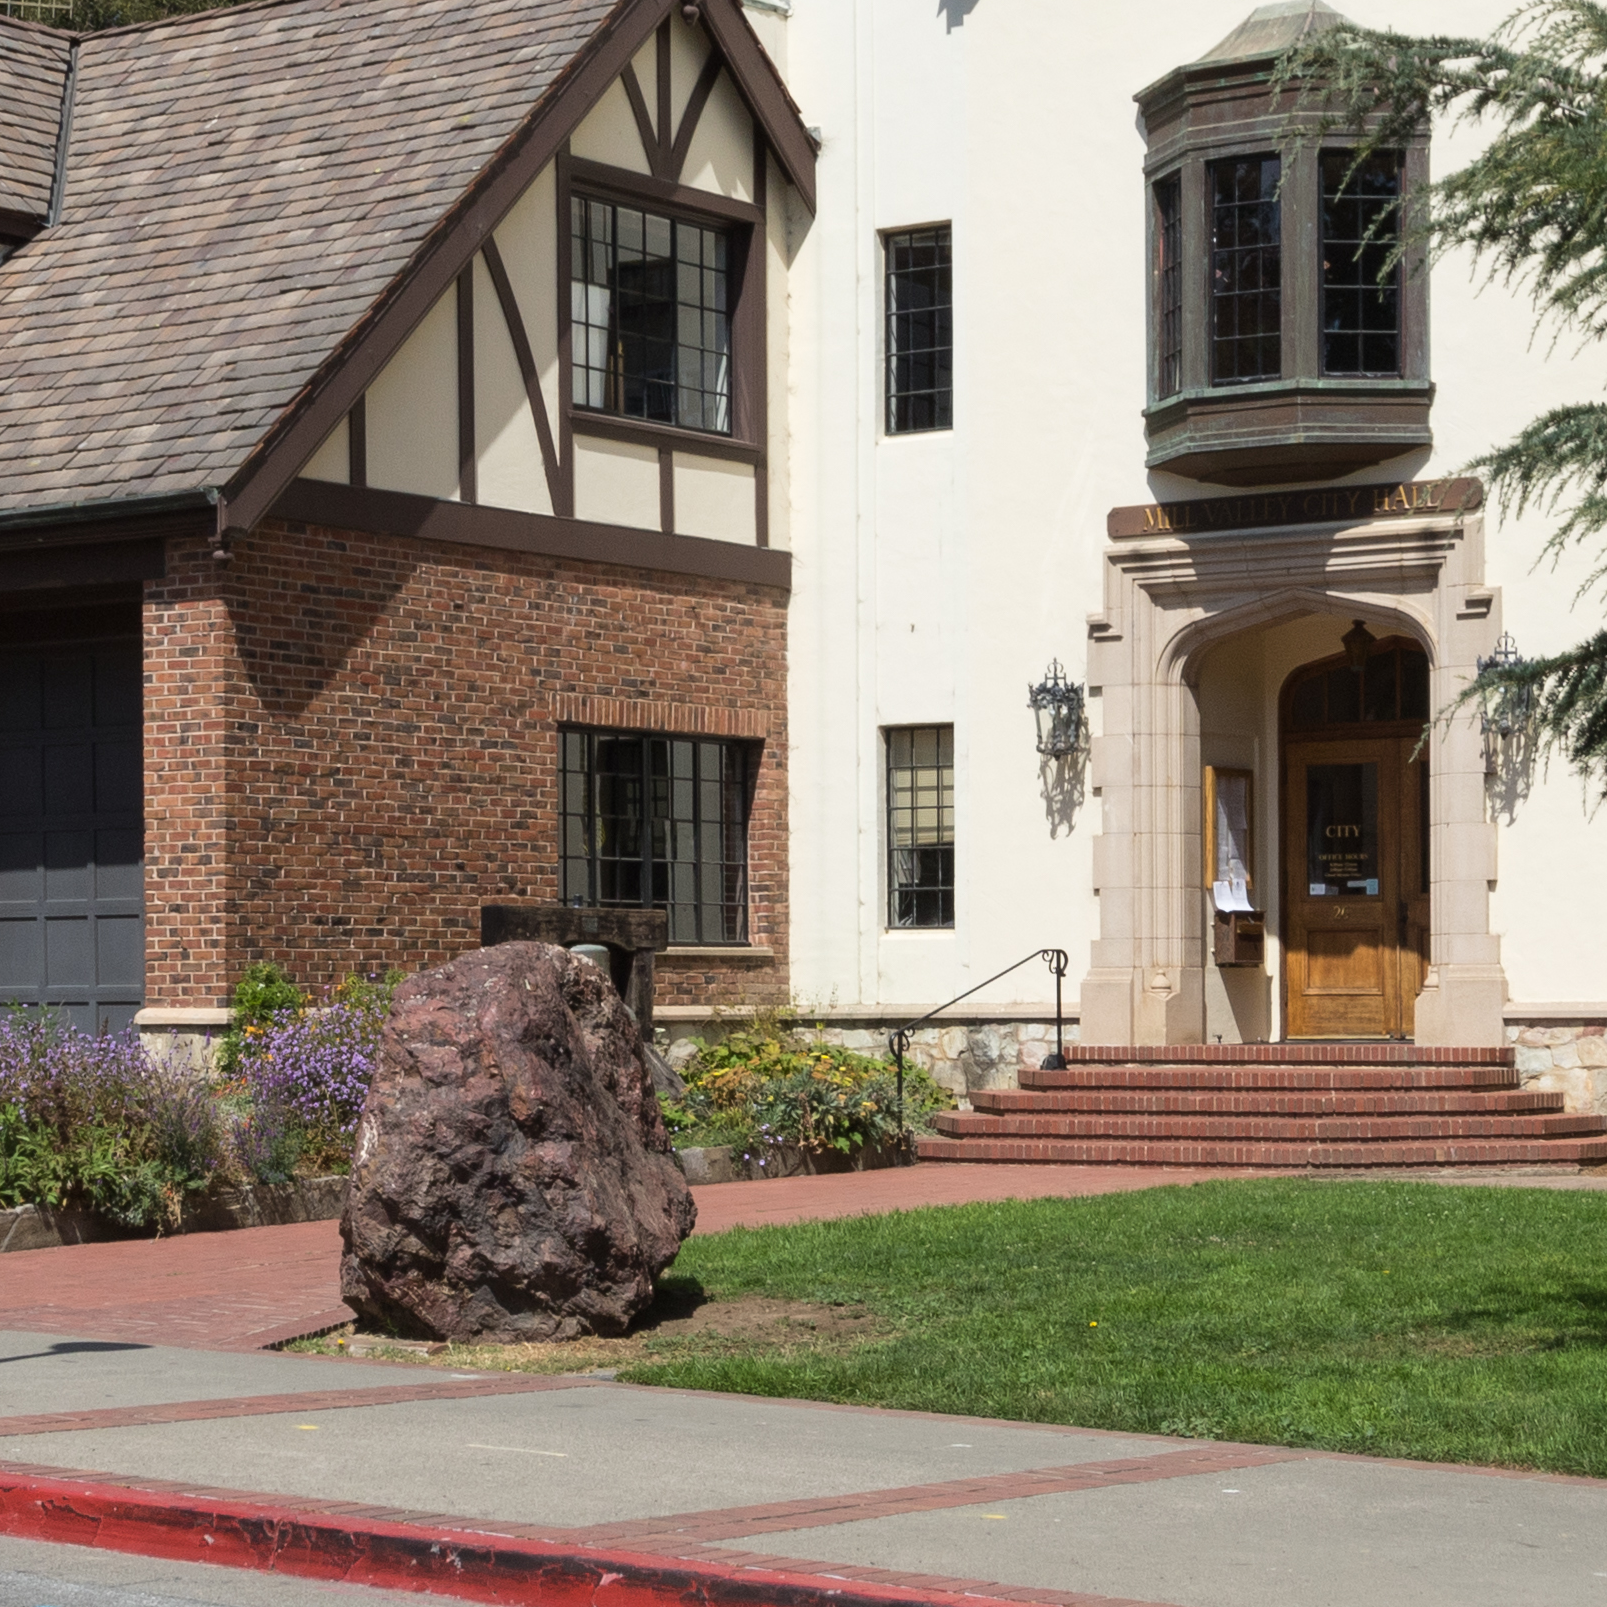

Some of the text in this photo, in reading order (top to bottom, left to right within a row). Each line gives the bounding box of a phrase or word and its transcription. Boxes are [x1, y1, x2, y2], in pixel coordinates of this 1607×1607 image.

[1143, 483, 1440, 532] MILL VALLEY CITY HALL
[1326, 825, 1362, 838] CITY
